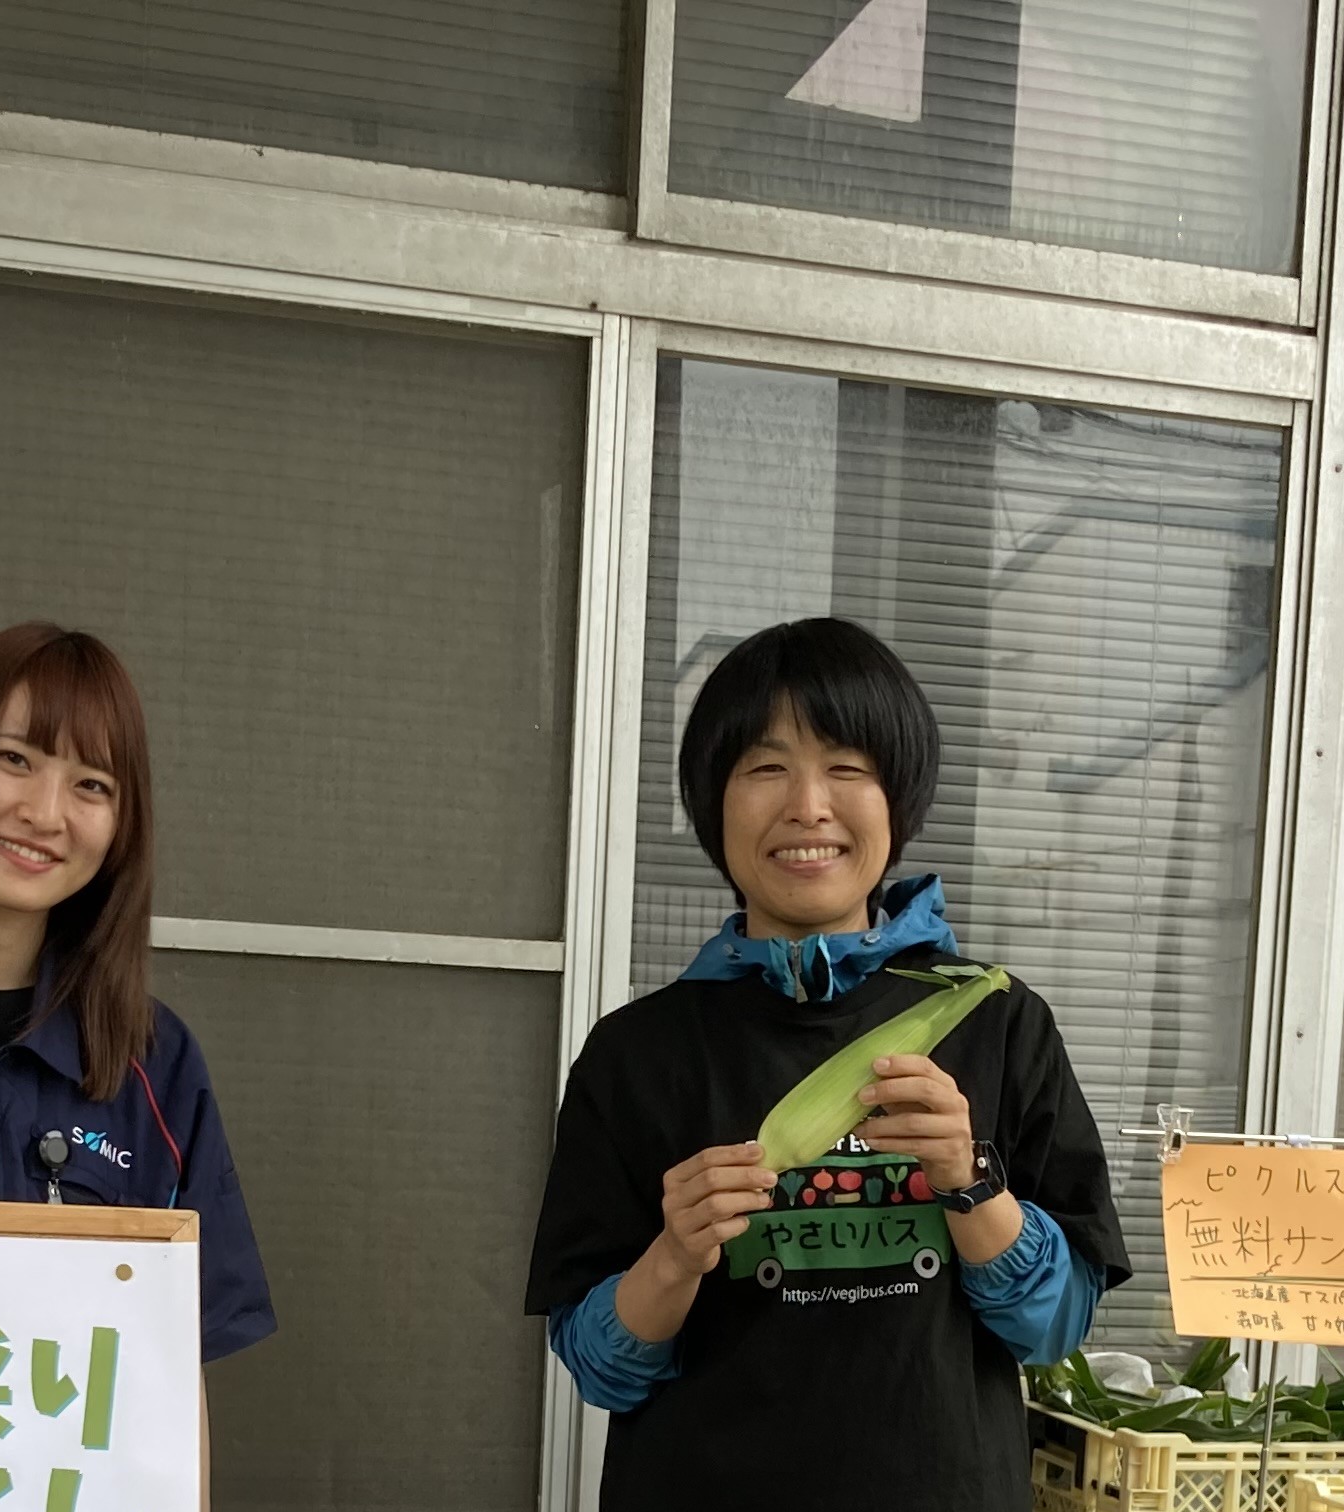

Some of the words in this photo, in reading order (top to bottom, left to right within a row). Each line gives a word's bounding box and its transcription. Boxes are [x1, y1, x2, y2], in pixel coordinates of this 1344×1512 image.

[71, 1126, 132, 1169] SOMIC
[762, 1216, 919, 1251] やさいバス
[783, 1282, 919, 1306] https://vegibus.com
